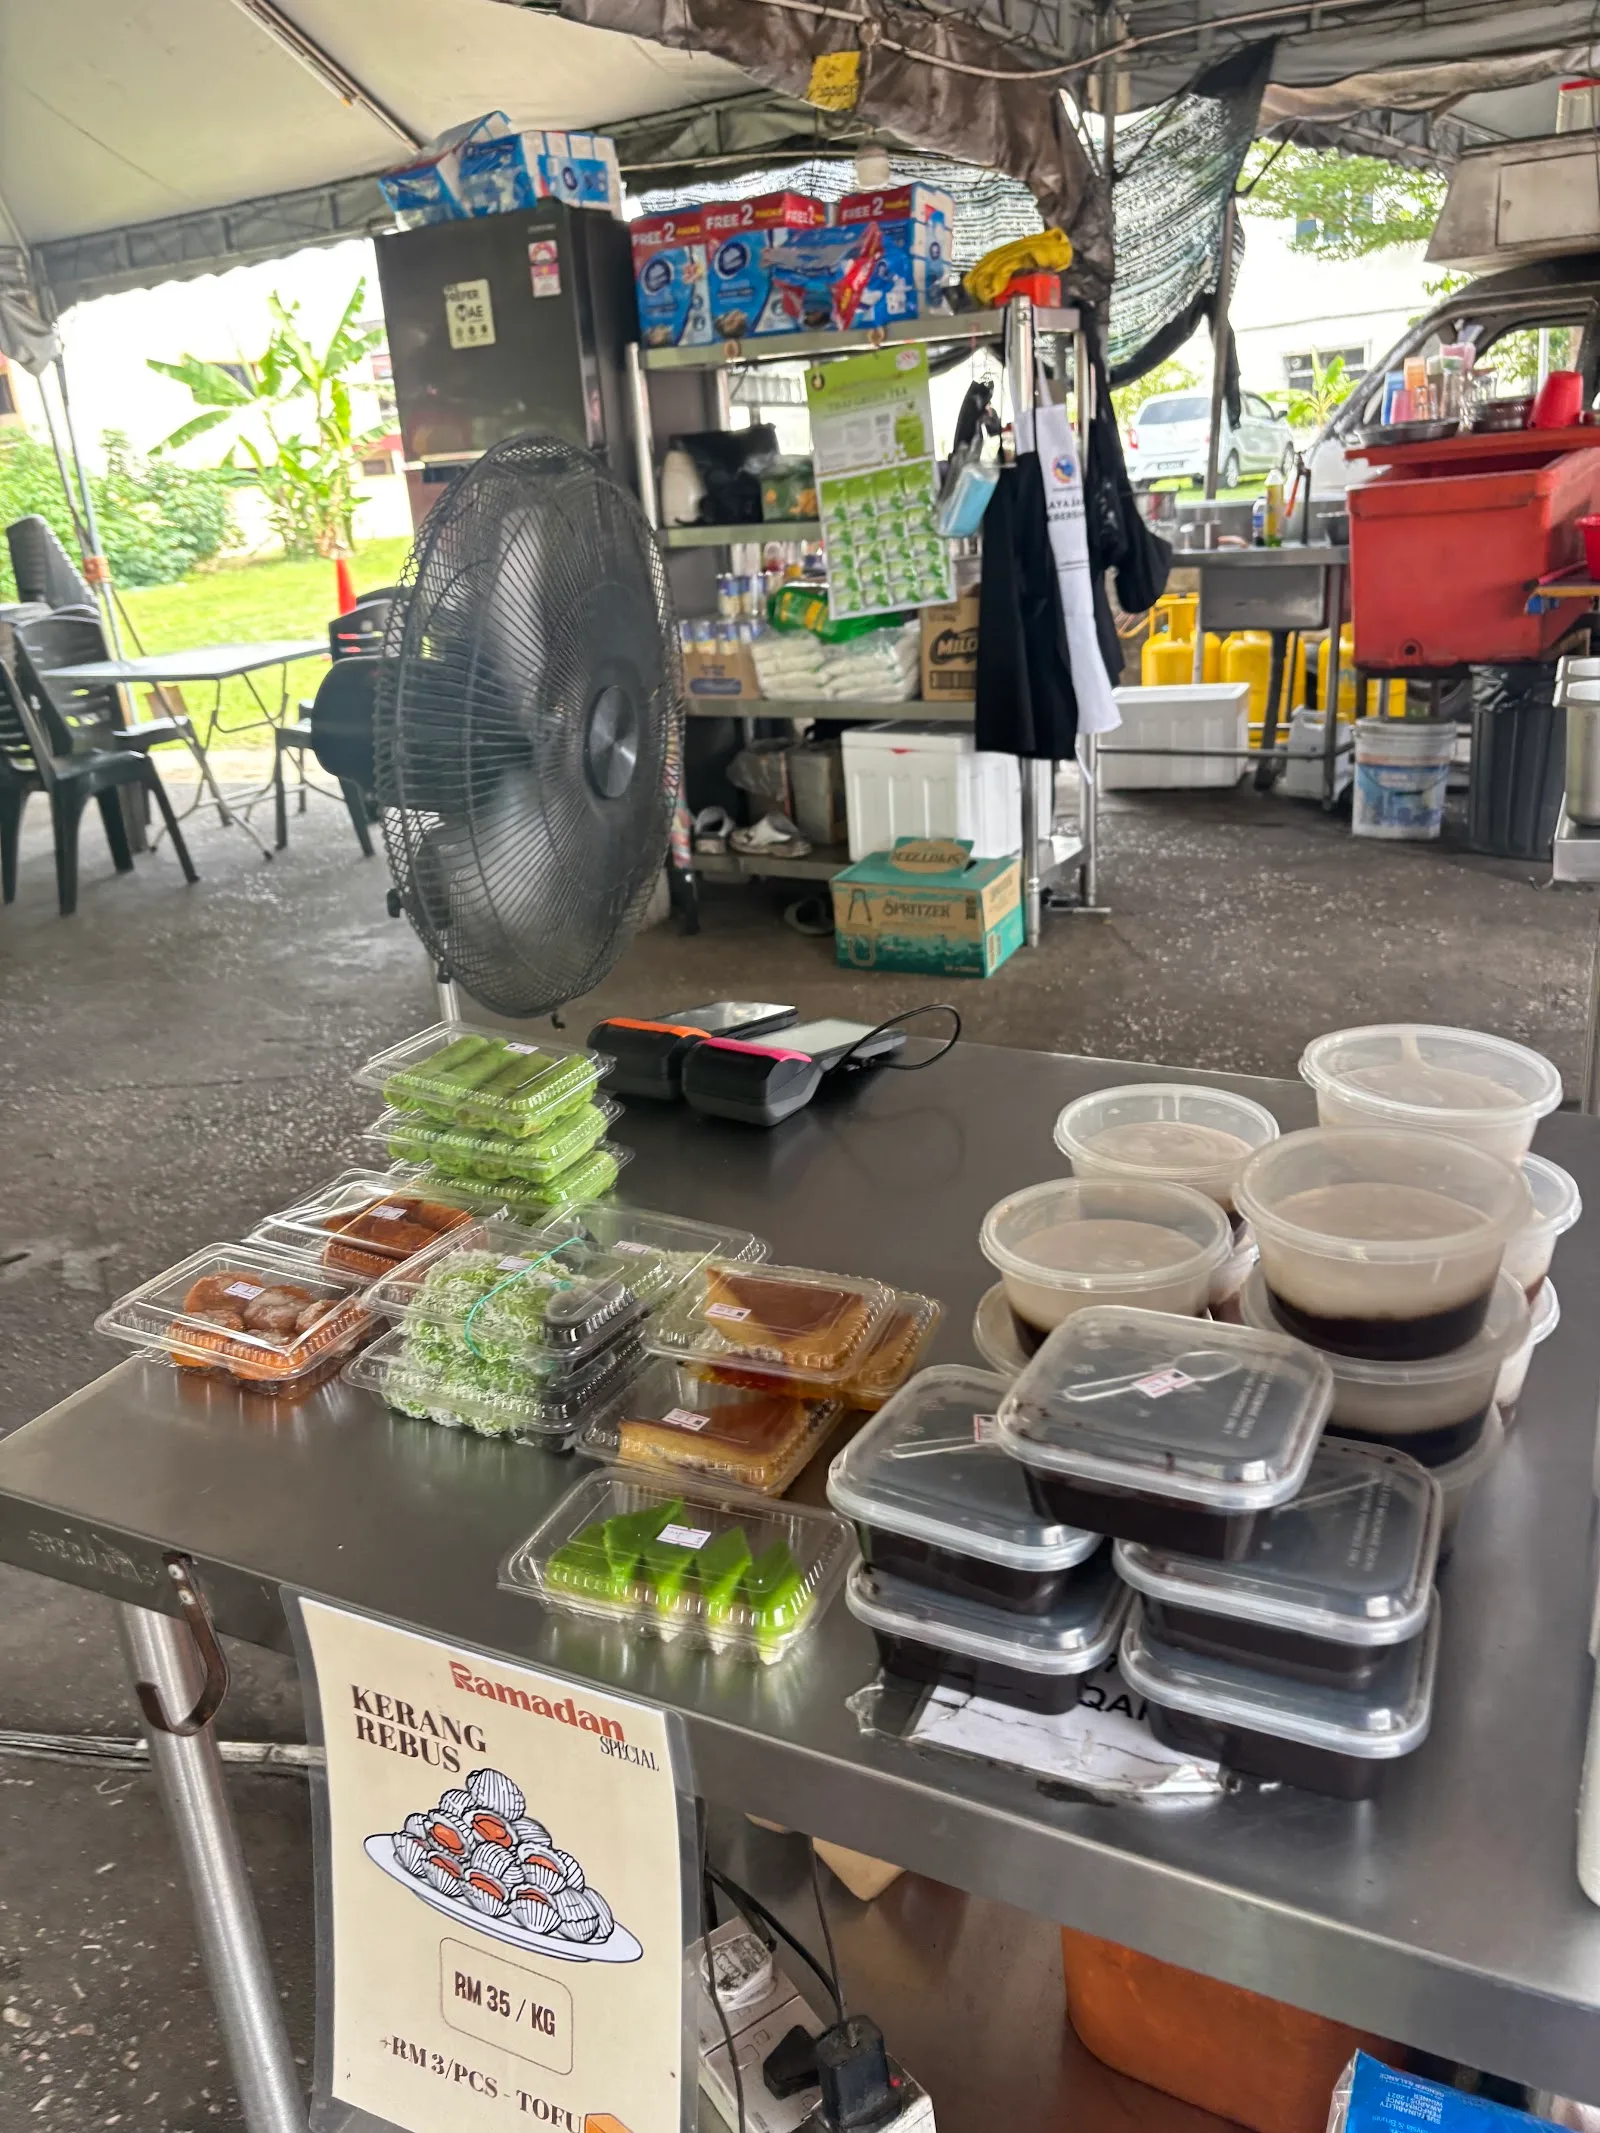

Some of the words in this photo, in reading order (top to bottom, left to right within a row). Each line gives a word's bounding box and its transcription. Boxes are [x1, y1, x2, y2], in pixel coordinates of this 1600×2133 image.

[705, 214, 739, 230] FREE
[741, 204, 753, 225] 2
[842, 205, 870, 221] FREE
[872, 197, 884, 216] 2
[632, 230, 661, 247] FREE
[663, 221, 675, 242] 2
[351, 1685, 487, 1752] KERANG
[449, 1661, 625, 1741] Ramadan
[355, 1714, 461, 1773] REBUS
[600, 1736, 660, 1771] SPECIAL
[455, 1971, 481, 2005] RM
[487, 1985, 510, 2017] 35
[532, 2003, 555, 2036] KG
[432, 2053, 498, 2099] 3/PCS
[516, 2090, 582, 2133] TOFU
[1386, 2097, 1442, 2119] PERFORMANCE
[1380, 2101, 1441, 2124] SUSTAINABILITY
